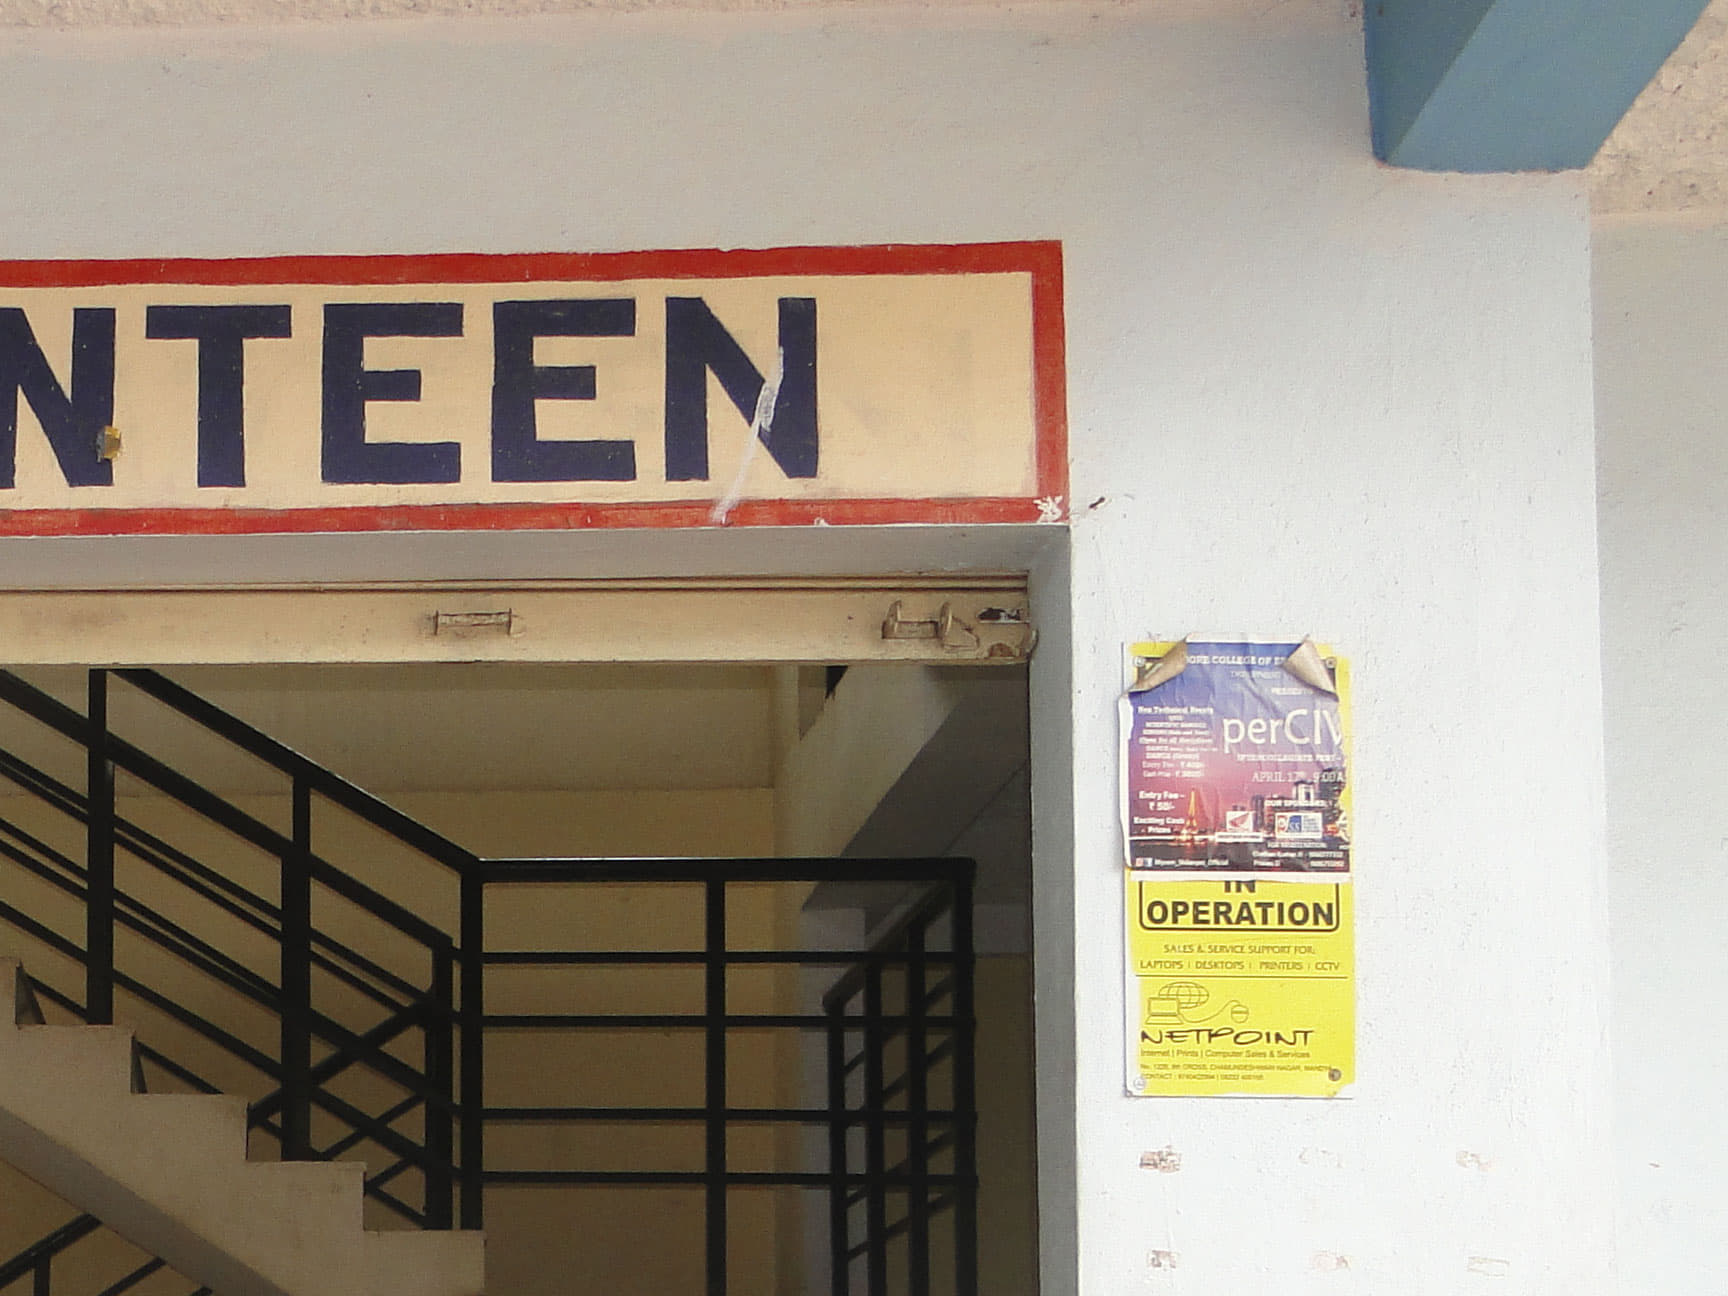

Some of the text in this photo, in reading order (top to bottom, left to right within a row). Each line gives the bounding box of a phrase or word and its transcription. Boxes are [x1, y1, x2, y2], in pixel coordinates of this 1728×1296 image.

[1212, 655, 1256, 665] COLLEGE
[1257, 656, 1272, 665] OF
[1252, 771, 1285, 782] APRIL
[1147, 900, 1334, 926] OPERATION
[1163, 944, 1194, 953] SALES
[1207, 944, 1245, 954] SERVICE
[1248, 944, 1291, 954] SUPPORT
[1140, 960, 1340, 971] LAPTOPS DESKTOPS PRINTERS CCTV
[1140, 1027, 1315, 1046] NETPOINT
